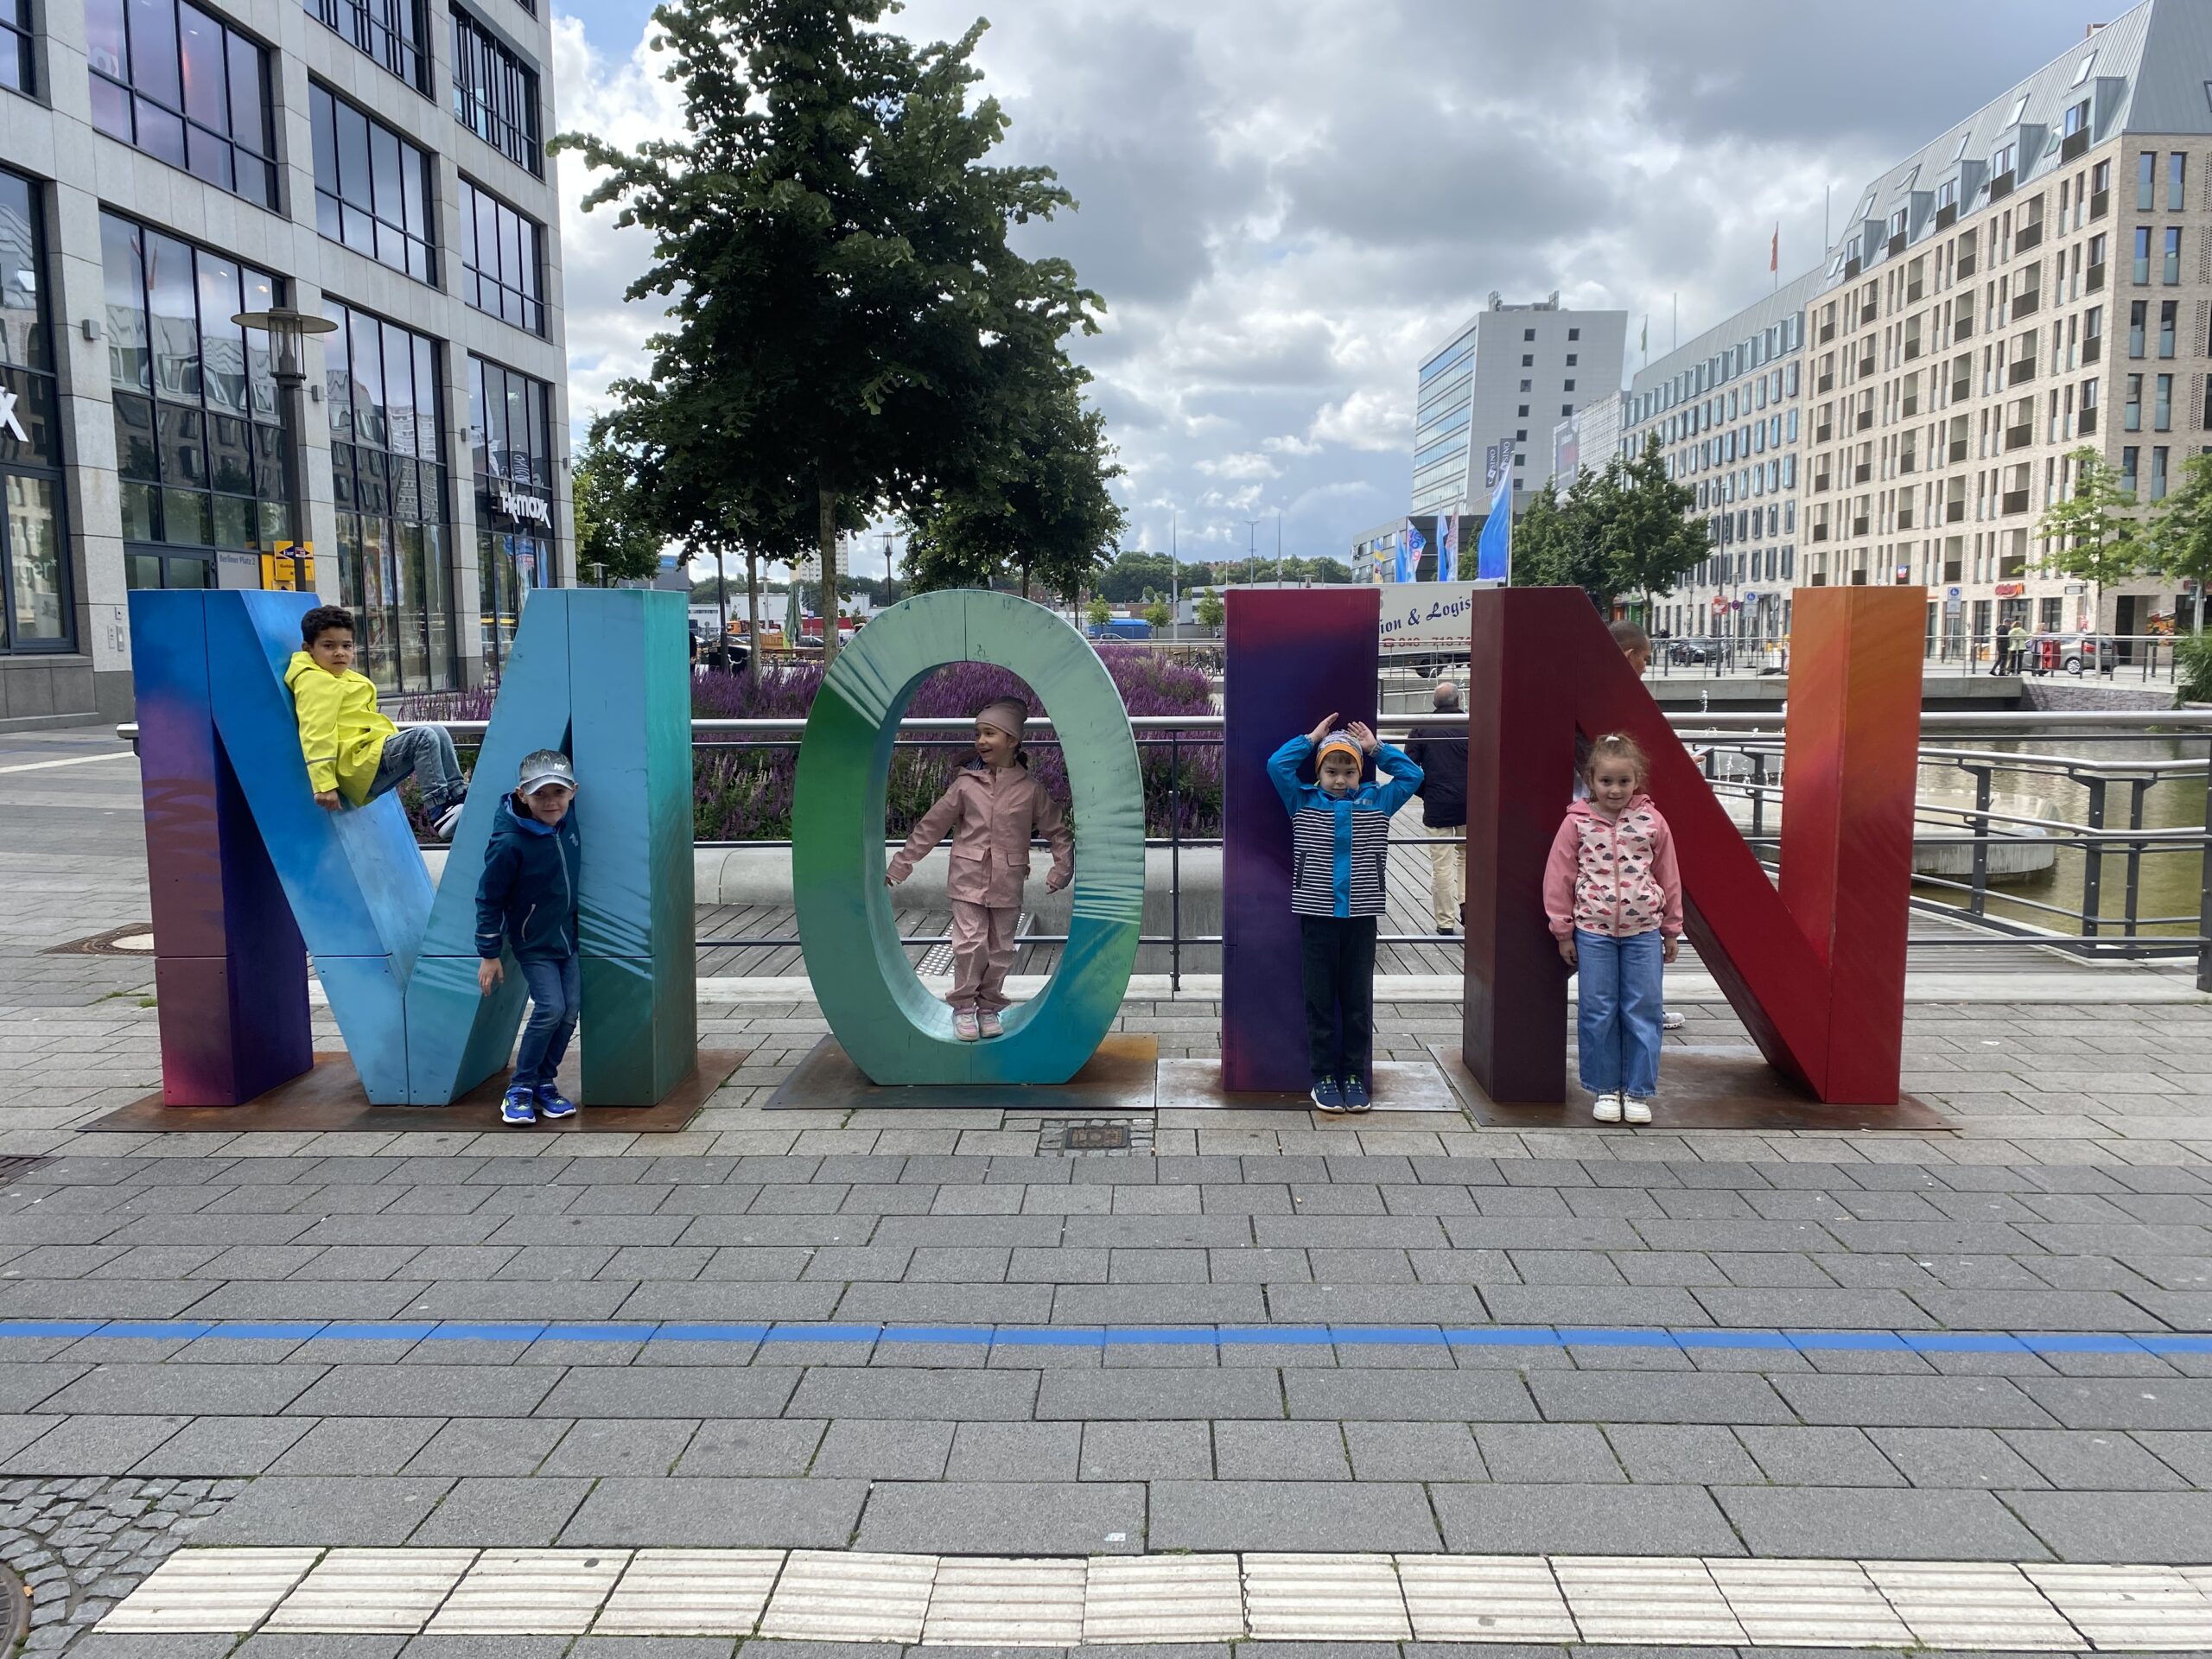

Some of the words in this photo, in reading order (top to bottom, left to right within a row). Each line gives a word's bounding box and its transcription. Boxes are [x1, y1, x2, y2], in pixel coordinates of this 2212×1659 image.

[219, 554, 238, 563] Berliner
[239, 556, 251, 565] Platz
[1380, 620, 1402, 633] ion
[1408, 608, 1420, 626] &
[1426, 596, 1472, 621] Logis
